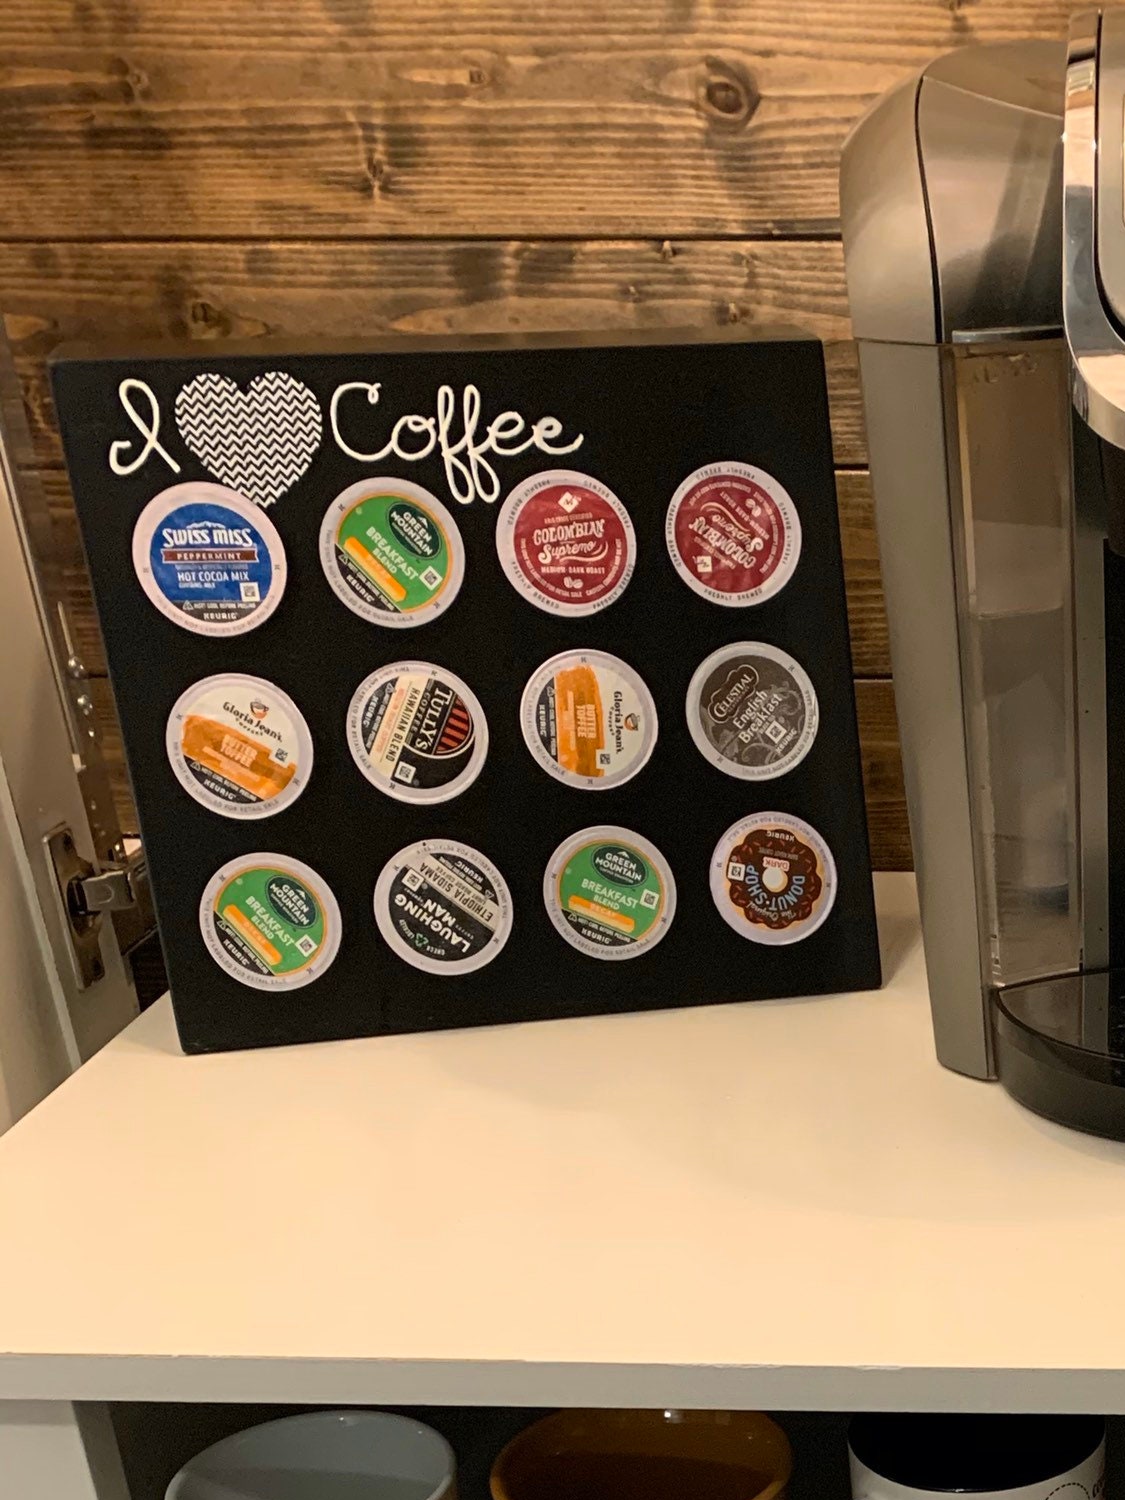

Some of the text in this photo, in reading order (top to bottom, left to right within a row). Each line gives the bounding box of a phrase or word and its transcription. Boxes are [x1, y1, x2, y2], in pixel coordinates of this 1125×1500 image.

[330, 382, 584, 504] Coffee
[162, 528, 254, 548] SWISS MISS
[390, 511, 433, 556] MOUNTAIN
[403, 512, 432, 542] GREEN
[533, 519, 605, 545] COLOMBIAN
[177, 552, 241, 560] PEPPERMINT
[366, 526, 419, 580] BREAKFAST
[538, 541, 596, 564] Supremo
[688, 516, 756, 569] COLOMBIAN
[372, 548, 398, 574] BLEND
[177, 571, 249, 582] HOT COCOA MIX
[346, 574, 375, 603] KEURIG
[204, 612, 238, 620] KEURIG
[396, 687, 420, 732] HAWAIIAN
[614, 691, 623, 724] Gloria
[714, 674, 754, 718] CELESTIAL
[732, 690, 768, 729] English
[222, 701, 254, 725] Gloria
[363, 696, 379, 728] KEURIG
[412, 693, 431, 733] COFFEE
[416, 688, 453, 750] TULLY'S
[539, 704, 547, 737] KEURIG
[576, 704, 587, 738] TOFFEE
[738, 693, 783, 744] Breakfast
[386, 732, 403, 762] BLEND
[775, 728, 798, 754] KEURIG
[220, 746, 252, 768] TOFFEE
[204, 779, 236, 800] KEURIG
[767, 831, 795, 842] KEURIG
[454, 860, 483, 883] KEURIG
[595, 857, 642, 881] MOUNTAIN
[605, 853, 637, 870] GREEN
[764, 860, 789, 870] DARK
[420, 862, 453, 894] SIDAMA
[745, 865, 805, 911] DONUT SHOP
[270, 883, 310, 925] MOUNTAIN
[282, 884, 309, 913] GREEN
[454, 892, 494, 922] ETHIOPIA
[581, 878, 638, 909] BREAKFAST
[593, 895, 620, 910] BLEND
[245, 895, 294, 946] BREAKFAST
[251, 915, 274, 940] BLEND
[394, 894, 471, 953] LAUGHING
[423, 899, 456, 927] MAN
[581, 928, 611, 944] KEURIG
[223, 939, 250, 966] KEURIG
